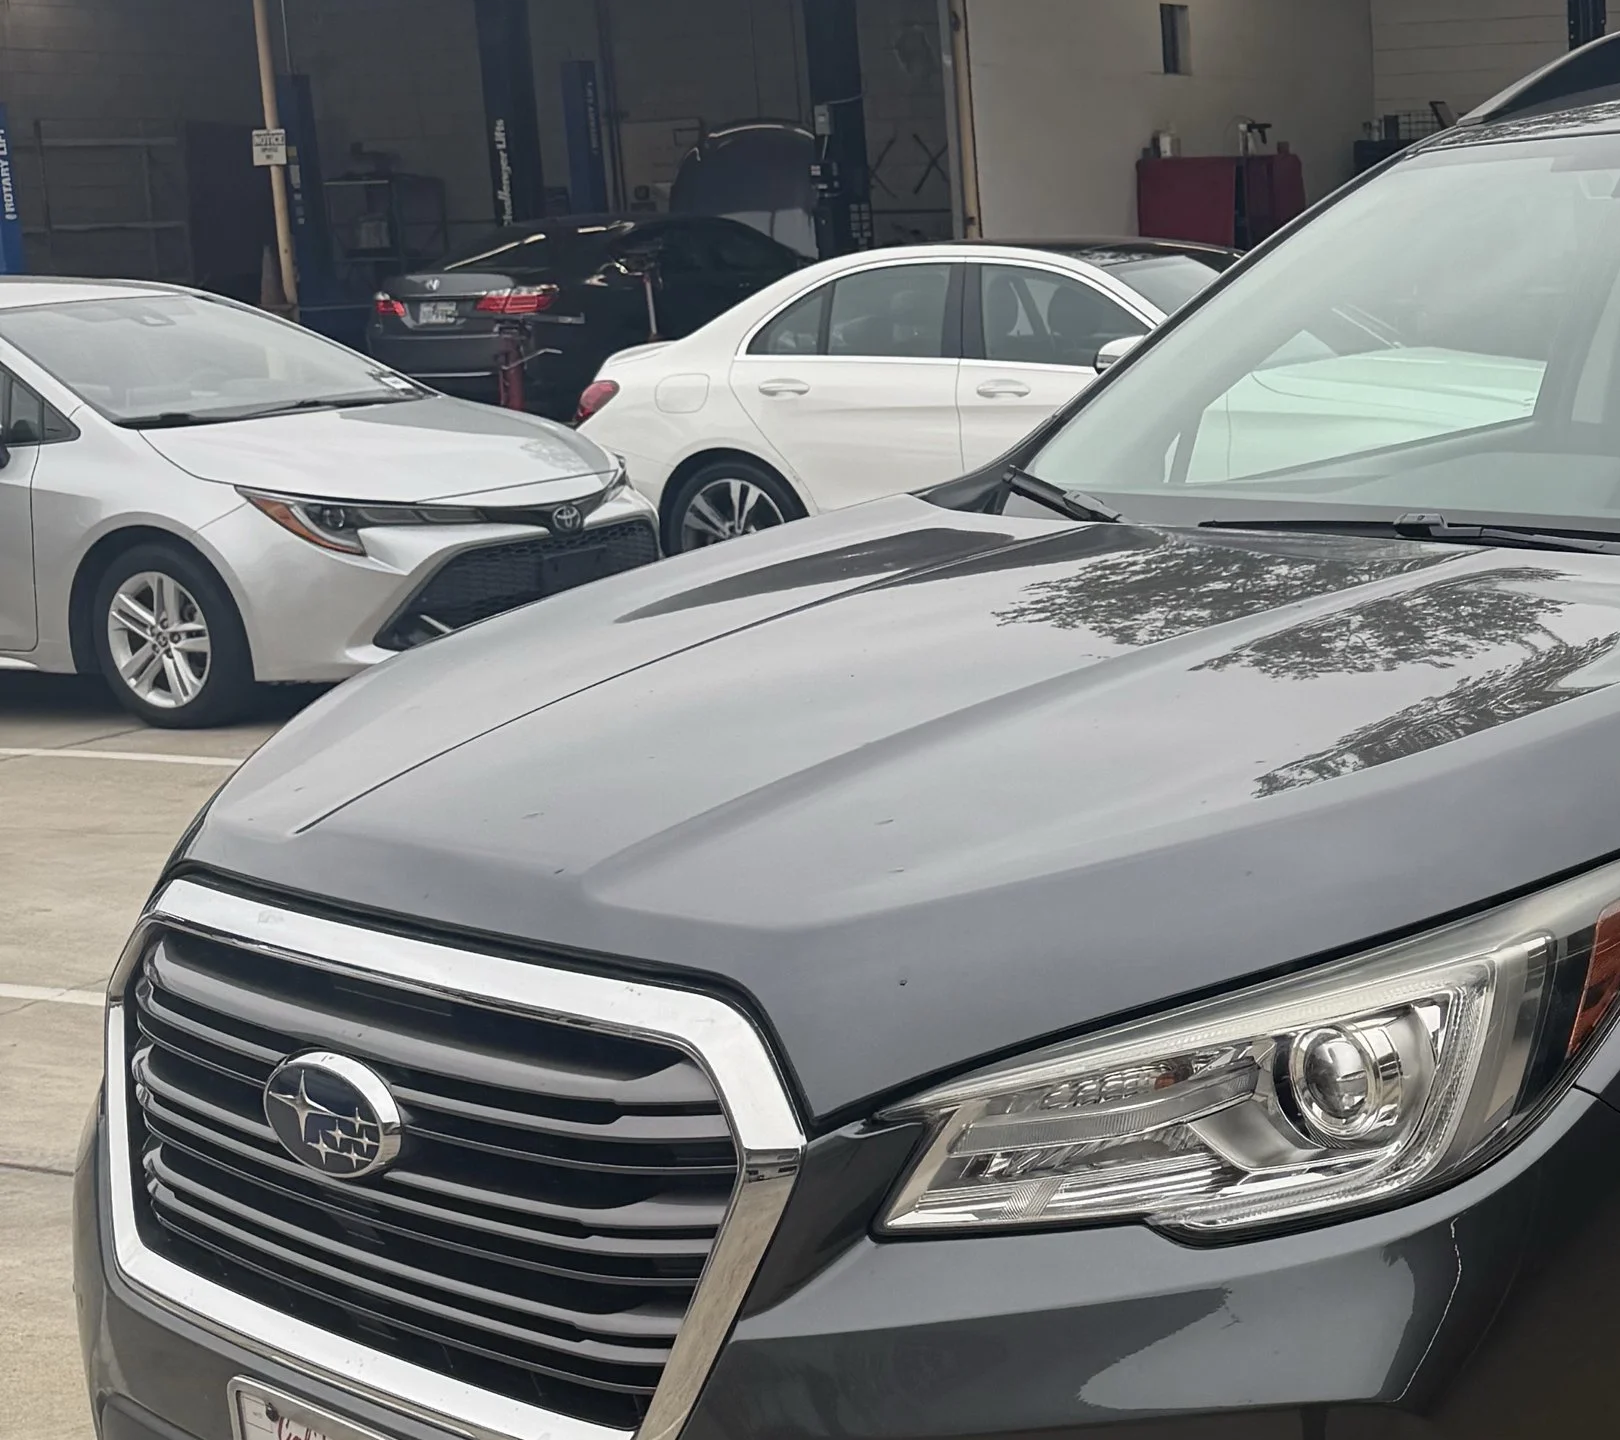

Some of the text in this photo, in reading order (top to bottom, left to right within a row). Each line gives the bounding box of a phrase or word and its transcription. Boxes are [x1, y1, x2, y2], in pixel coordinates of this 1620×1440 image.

[253, 134, 285, 146] NOTICE
[493, 118, 507, 150] Lifts
[0, 160, 15, 213] ROTARY
